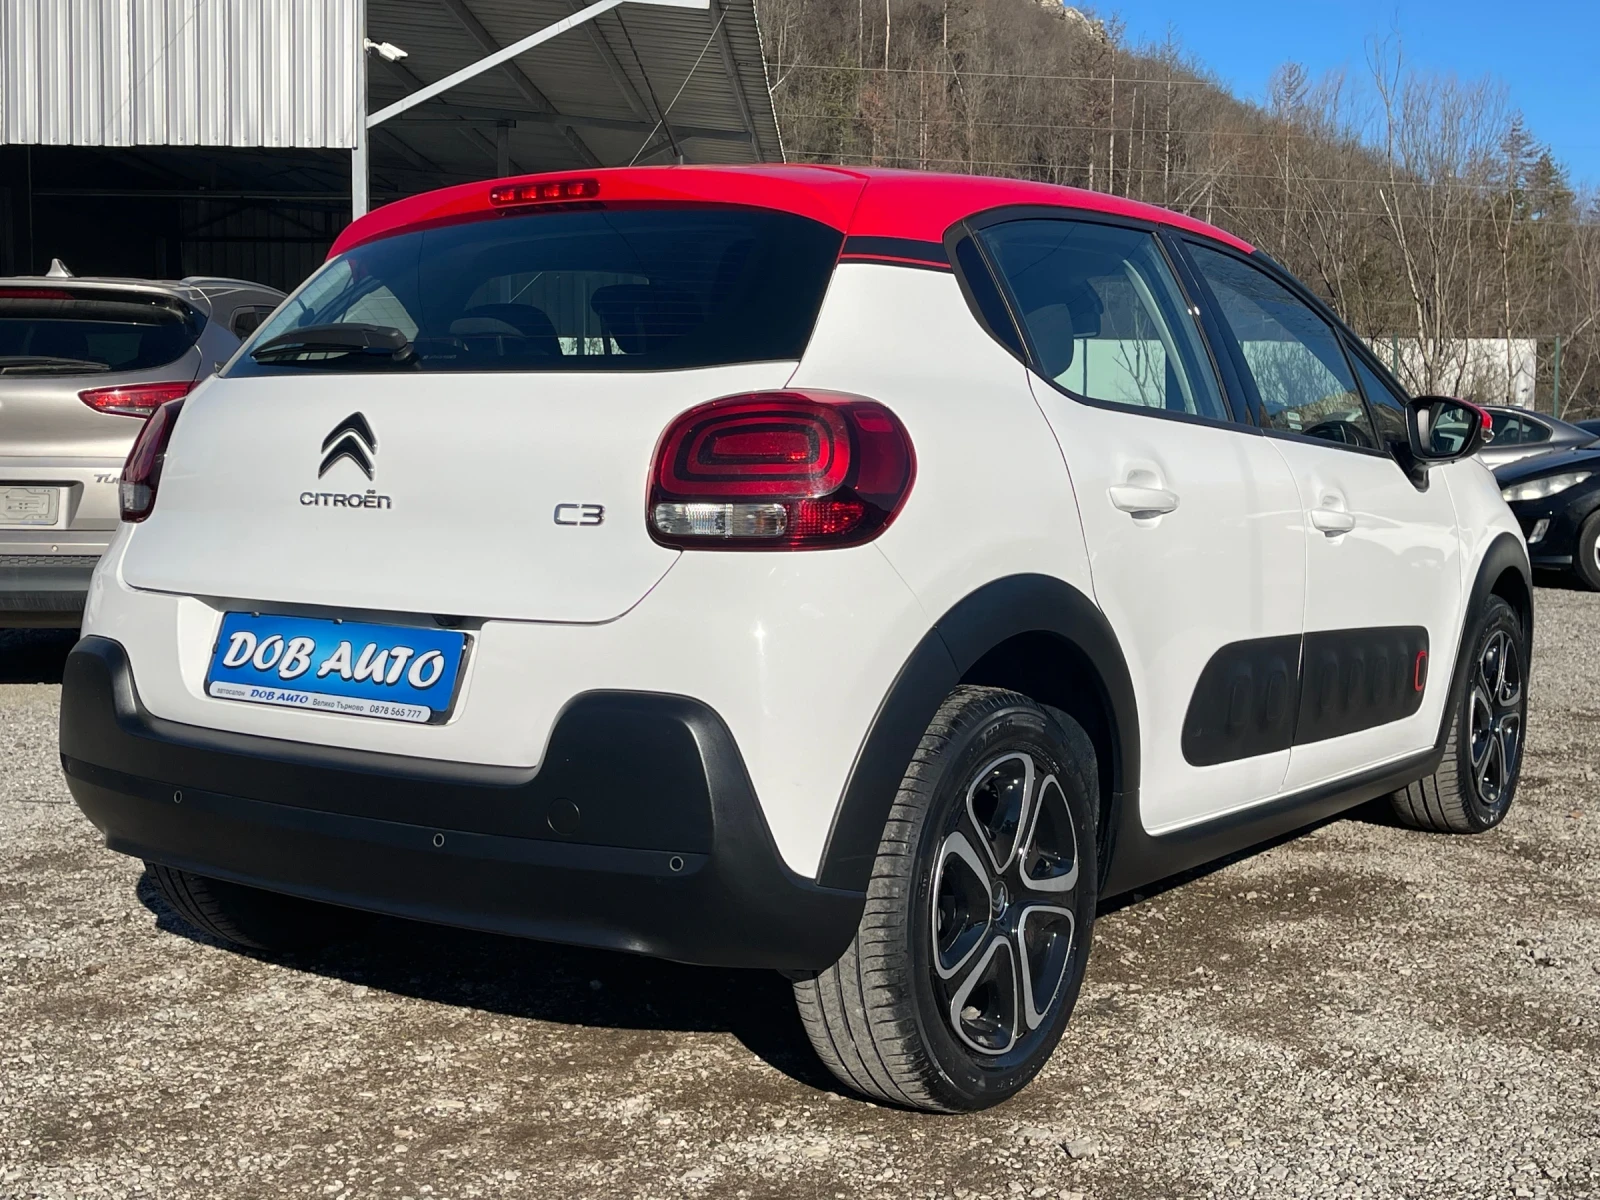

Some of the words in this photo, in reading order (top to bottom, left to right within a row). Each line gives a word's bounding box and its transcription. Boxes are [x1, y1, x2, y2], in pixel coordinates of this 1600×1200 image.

[553, 503, 606, 526] C3
[222, 631, 316, 679] DOB
[316, 640, 446, 690] AUTO
[250, 689, 276, 701] DOB
[276, 692, 309, 704] AUTO
[312, 698, 335, 709] Велико
[369, 704, 390, 716] 0878
[390, 707, 405, 718] 565
[406, 709, 422, 719] 777
